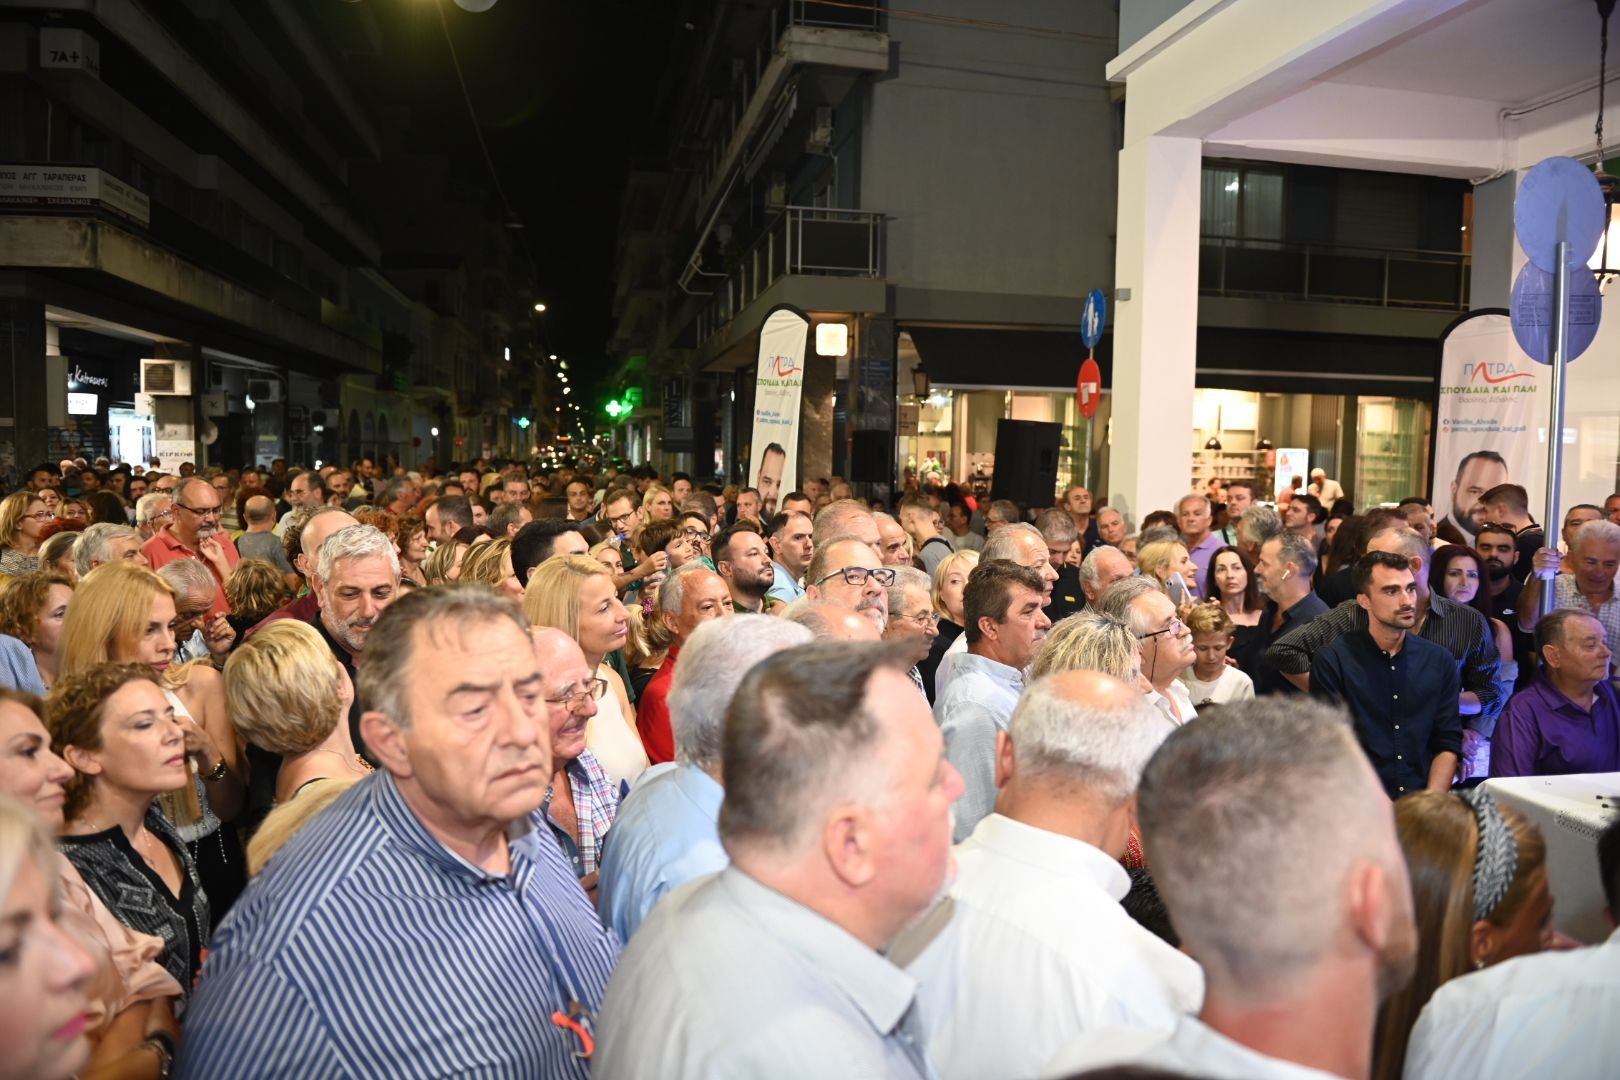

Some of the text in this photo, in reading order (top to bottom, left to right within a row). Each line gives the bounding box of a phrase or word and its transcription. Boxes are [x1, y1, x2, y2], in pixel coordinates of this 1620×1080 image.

[1440, 385, 1537, 394] ΣΠΟΥΔΑΙΑ ΚΑΙ ΠΑΛΙ
